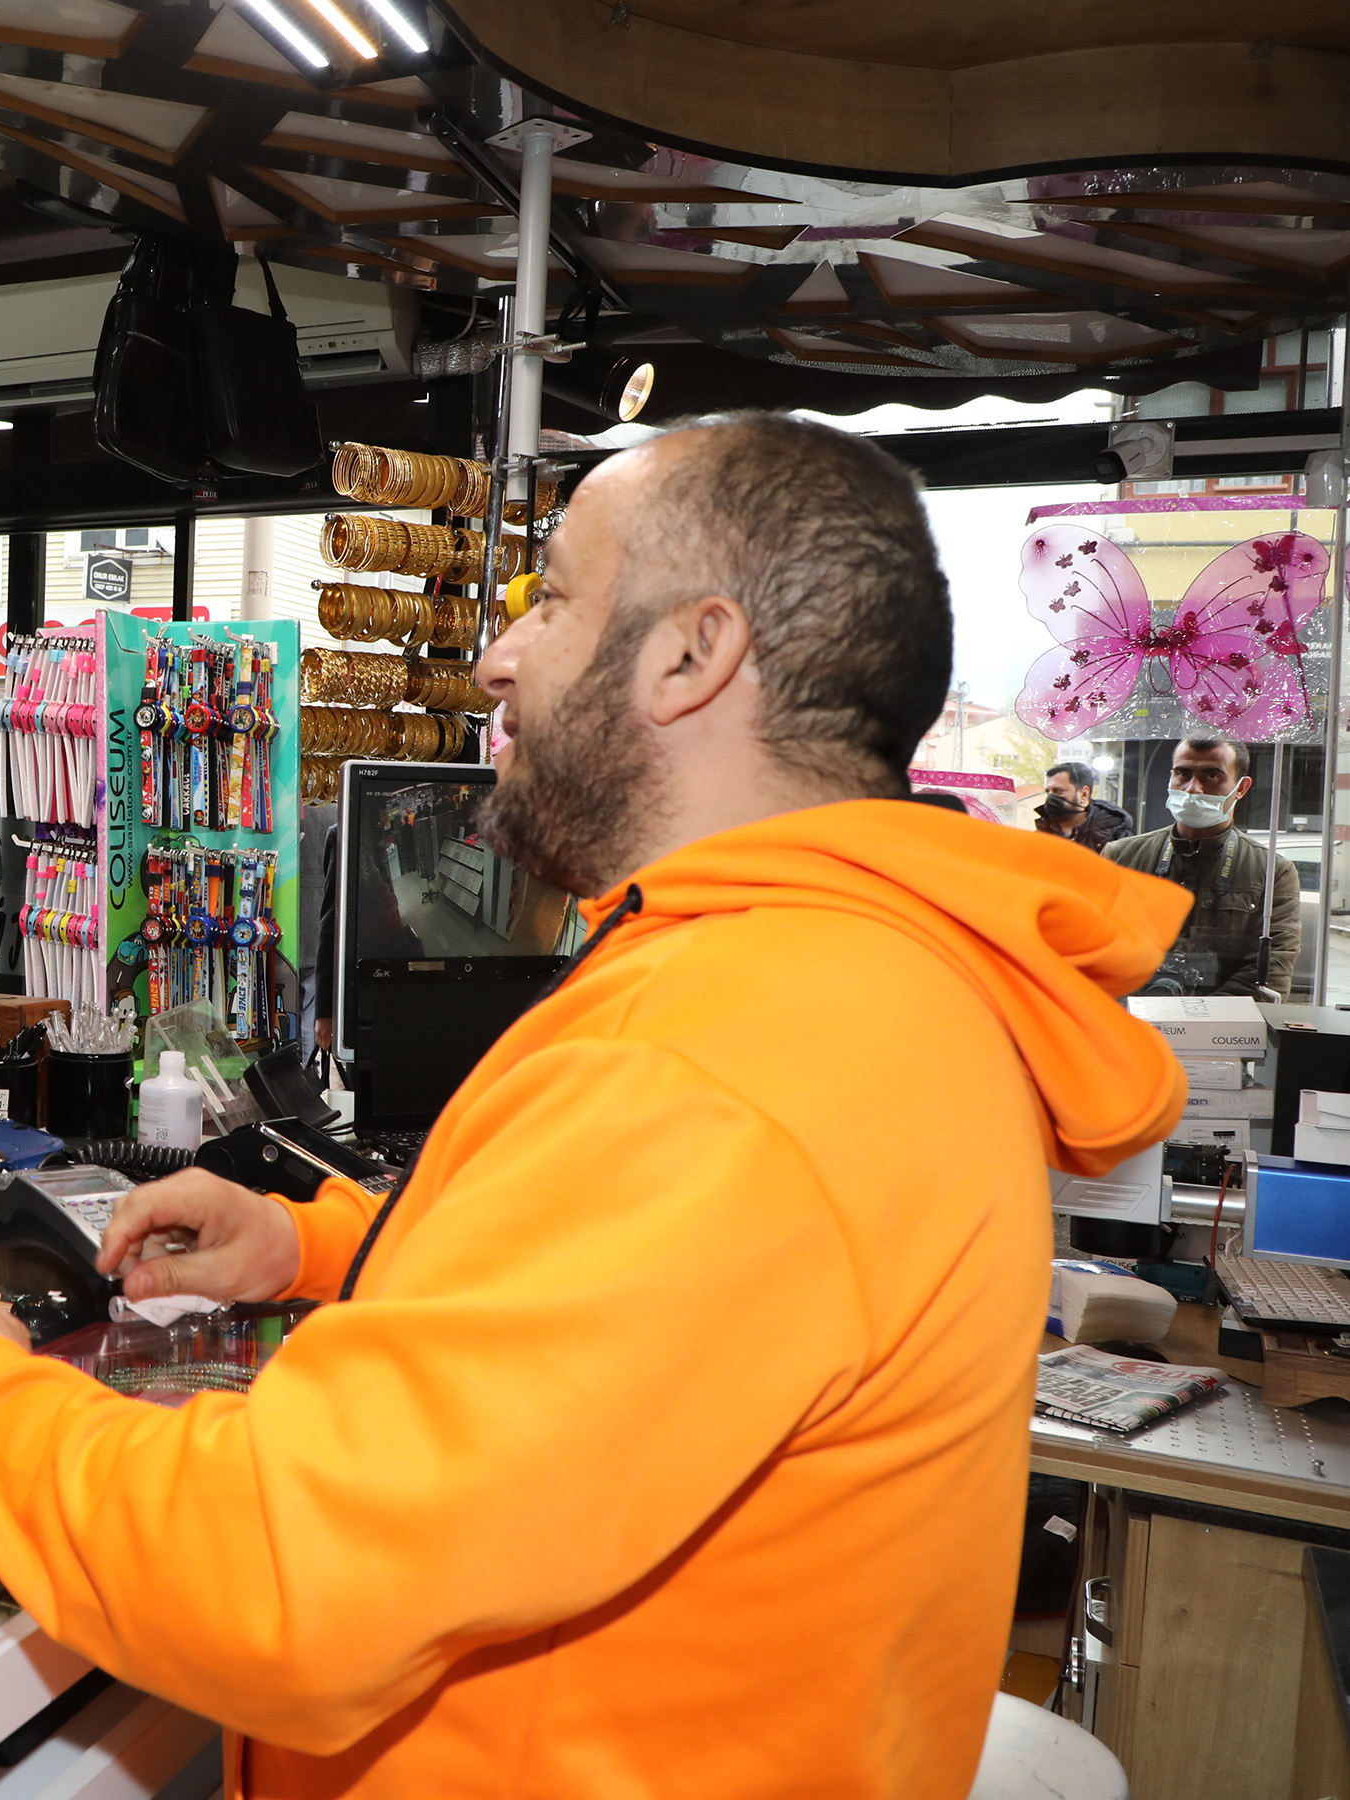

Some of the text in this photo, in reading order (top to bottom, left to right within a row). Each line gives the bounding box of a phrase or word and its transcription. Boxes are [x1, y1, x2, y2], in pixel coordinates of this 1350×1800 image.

[93, 572, 124, 582] ONUR EMLAK
[109, 708, 126, 910] COLISEUM
[1221, 857, 1232, 878] Nikon
[153, 884, 161, 900] SPAC
[384, 970, 391, 978] PC
[150, 983, 159, 1008] SPACE
[238, 986, 247, 1012] SPACE
[1211, 1036, 1261, 1046] COLISEUM
